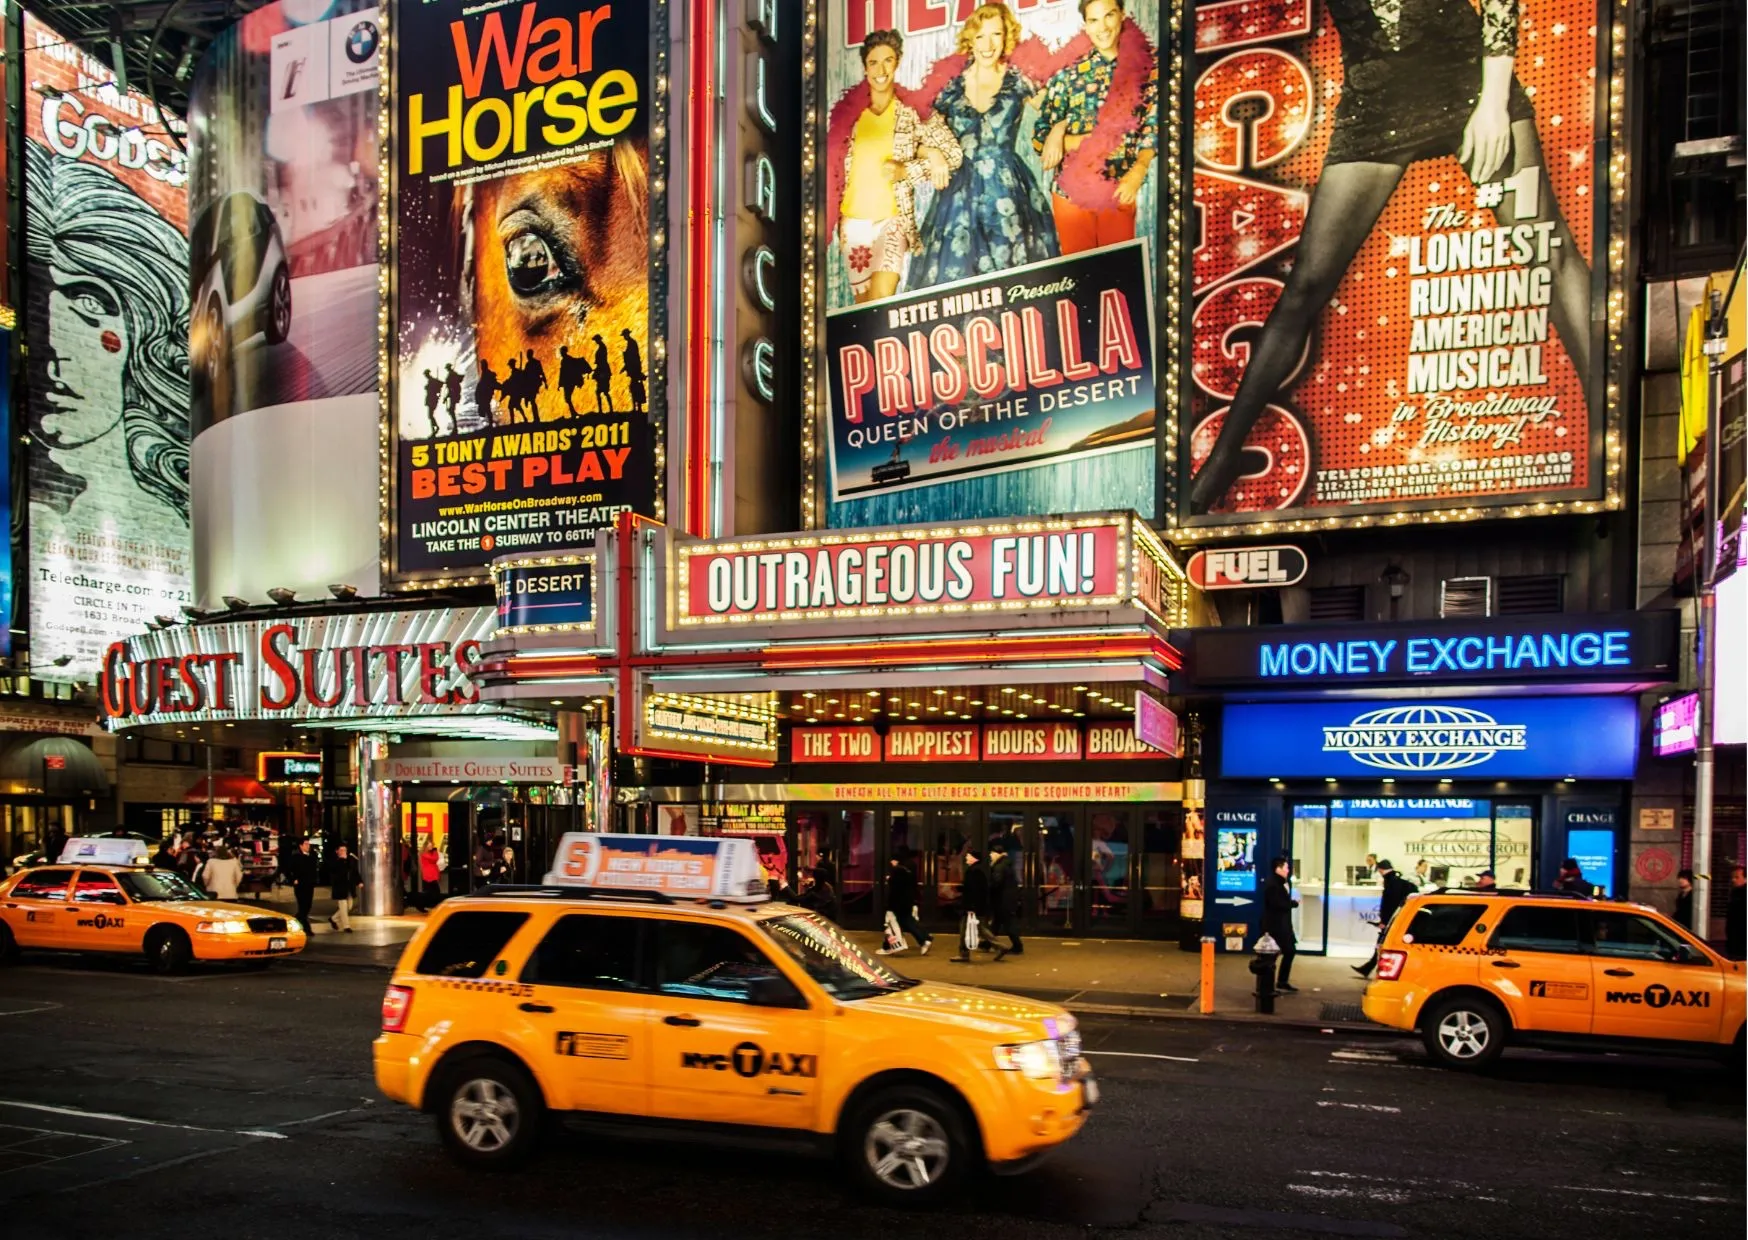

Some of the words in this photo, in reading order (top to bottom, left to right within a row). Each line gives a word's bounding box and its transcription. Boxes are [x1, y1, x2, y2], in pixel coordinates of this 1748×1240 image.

[450, 2, 611, 99] War
[408, 69, 638, 175] Horse
[575, 143, 589, 153] Nick
[1474, 166, 1541, 220] #1
[1423, 203, 1468, 229] The
[1409, 221, 1562, 275] LONGEST-
[888, 300, 939, 328] BETTE
[942, 287, 1003, 316] MIDLER
[1007, 276, 1075, 304] Presents
[1409, 266, 1551, 319] RUNNING
[1409, 308, 1549, 352] AMERICAN
[839, 288, 1143, 424] PRISCILLA
[1408, 345, 1547, 394] MUSICAL
[848, 418, 929, 448] QUEEN
[939, 408, 969, 430] OF
[980, 398, 1029, 422] THE
[1040, 375, 1142, 412] DESERT
[1392, 402, 1417, 422] in
[1423, 393, 1562, 423] Broadway
[411, 446, 429, 467] 5
[435, 438, 487, 465] TONY
[581, 422, 629, 448] 2011
[929, 436, 960, 464] the
[965, 418, 1053, 459] musical
[1419, 417, 1528, 450] History!
[411, 460, 513, 499] BEST
[522, 447, 632, 488] PLAY
[1516, 474, 1572, 487] BROADWAY
[439, 493, 602, 516] www.WarHorseOnBroadway.com
[411, 517, 481, 538] LINCOLN
[484, 510, 551, 532] CENTER
[426, 540, 455, 552] TAKE
[457, 537, 480, 551] THE
[495, 533, 543, 548] SUBWAY
[546, 531, 563, 543] TO
[565, 529, 595, 541] 66TH
[707, 541, 974, 613] OUTRAGEOUS
[993, 531, 1095, 598] FUN!
[1206, 550, 1288, 584] FUEL
[39, 568, 153, 596] Telecharge.com
[161, 590, 174, 600] or
[516, 574, 585, 594] DESERT
[73, 596, 112, 610] CIRCLE
[117, 601, 128, 611] IN
[84, 610, 108, 621] 1633
[112, 614, 141, 625] Broad
[1260, 639, 1397, 676] MONEY
[1406, 631, 1631, 673] EXCHANGE
[802, 733, 833, 757] THE
[839, 732, 872, 756] TWO
[891, 731, 973, 756] HAPPIEST
[987, 730, 1046, 755] HOURS
[1053, 729, 1078, 754] ON
[1089, 727, 1184, 754] BROAD
[1323, 729, 1401, 748] MONEY
[1405, 729, 1527, 747] EXCHANGE
[835, 787, 872, 798] BENEATH
[877, 787, 891, 797] ALL
[896, 787, 917, 797] THAT
[922, 787, 948, 797] GLITZ
[951, 786, 978, 797] BEATS
[991, 787, 1019, 797] GREAT
[1024, 786, 1040, 797] BIG
[1044, 786, 1091, 798] SEQUINED
[1217, 812, 1257, 822] CHANGE
[1568, 812, 1615, 823] CHANGE
[564, 841, 592, 876] S
[1405, 843, 1426, 853] THE
[1431, 843, 1483, 854] CHANGE
[77, 919, 95, 928] NYC
[95, 913, 124, 930] TAXI
[1606, 991, 1642, 1004] NYC
[1644, 983, 1710, 1008] TAXI
[680, 1051, 731, 1071] NYC
[731, 1041, 818, 1078] TAXI
